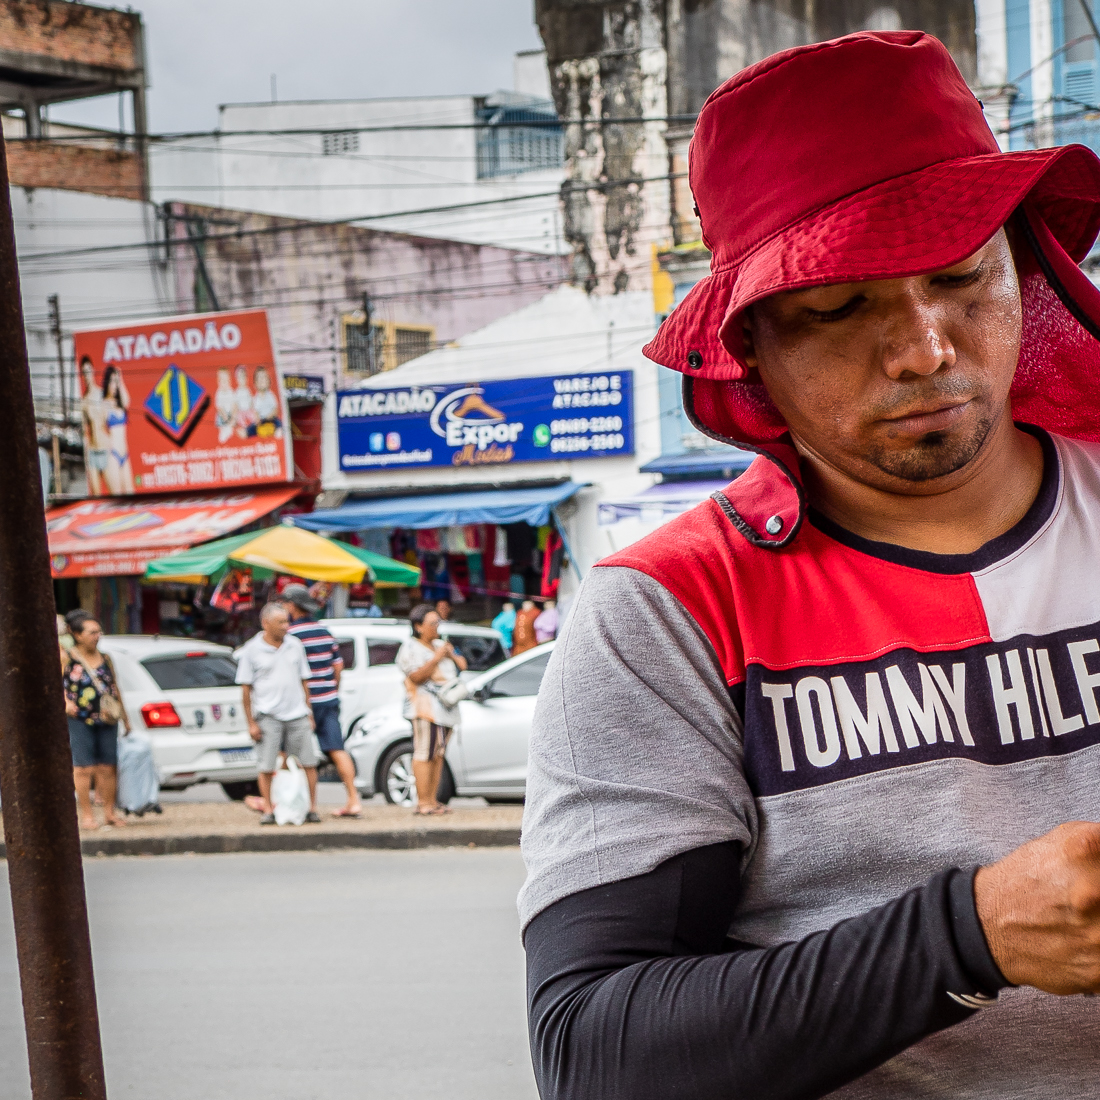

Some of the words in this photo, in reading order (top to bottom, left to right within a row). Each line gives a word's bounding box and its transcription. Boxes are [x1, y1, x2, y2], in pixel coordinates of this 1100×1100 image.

[103, 321, 242, 363] ATACADÃO
[552, 390, 622, 409] ATACADO
[553, 376, 609, 393] VAREJO
[610, 375, 622, 390] E
[339, 386, 437, 418] ATACADÃO
[446, 420, 524, 451] Expor
[761, 662, 976, 772] TOMMY
